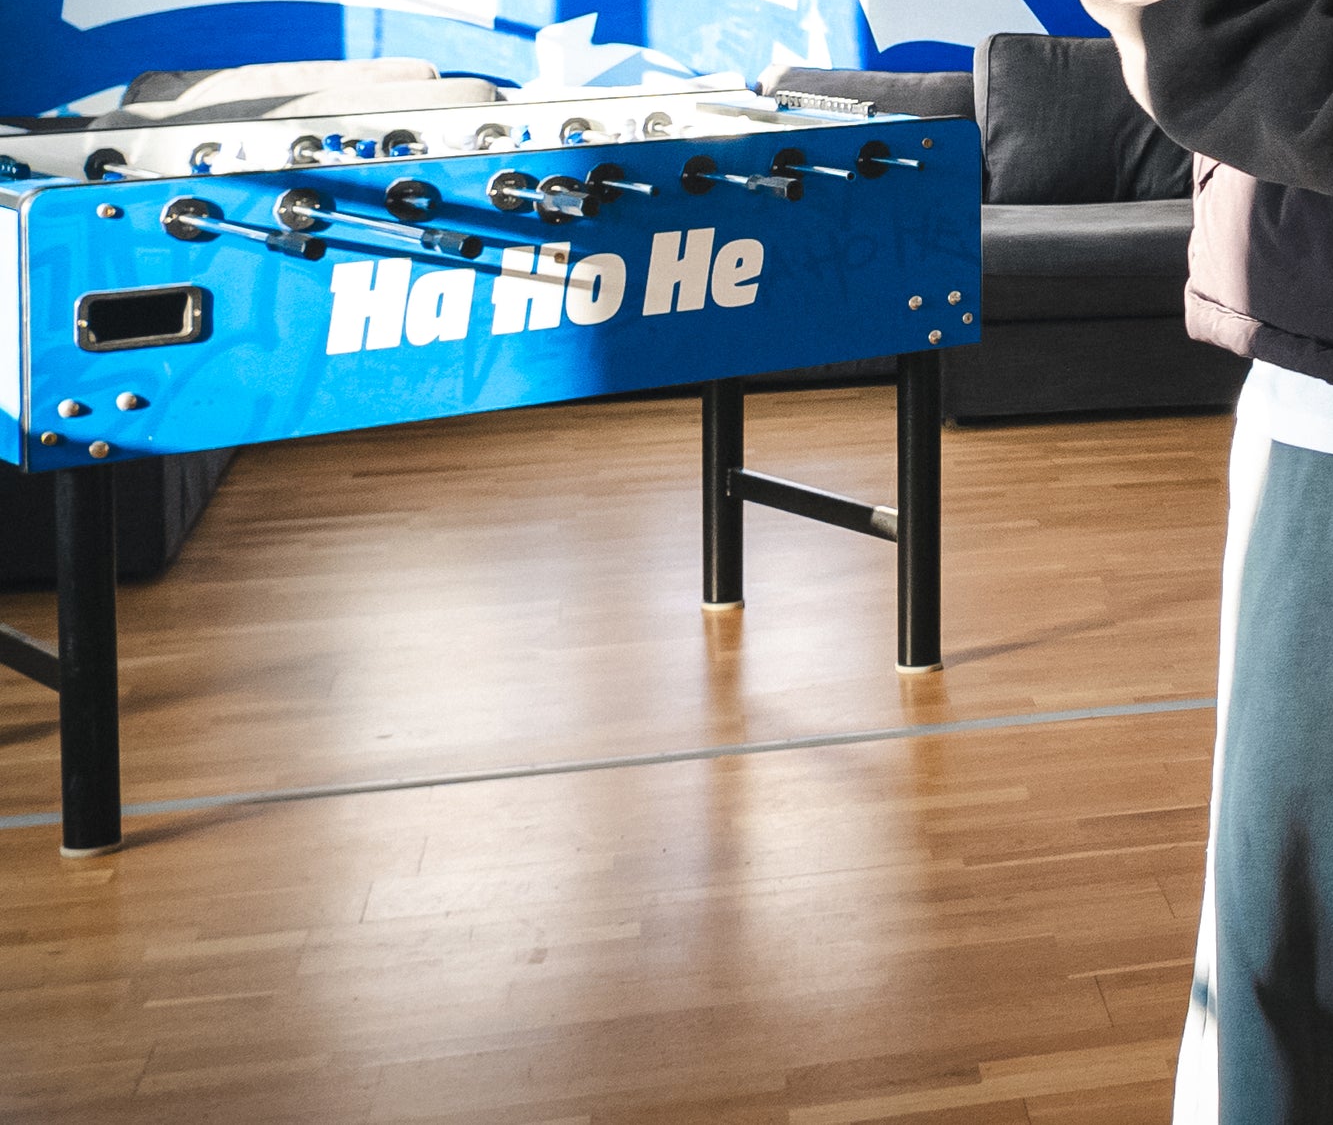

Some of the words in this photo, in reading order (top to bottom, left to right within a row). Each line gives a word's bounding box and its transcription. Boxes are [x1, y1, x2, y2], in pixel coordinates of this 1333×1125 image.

[326, 257, 476, 356] Ha
[491, 242, 627, 335] Ho
[642, 227, 765, 316] He
